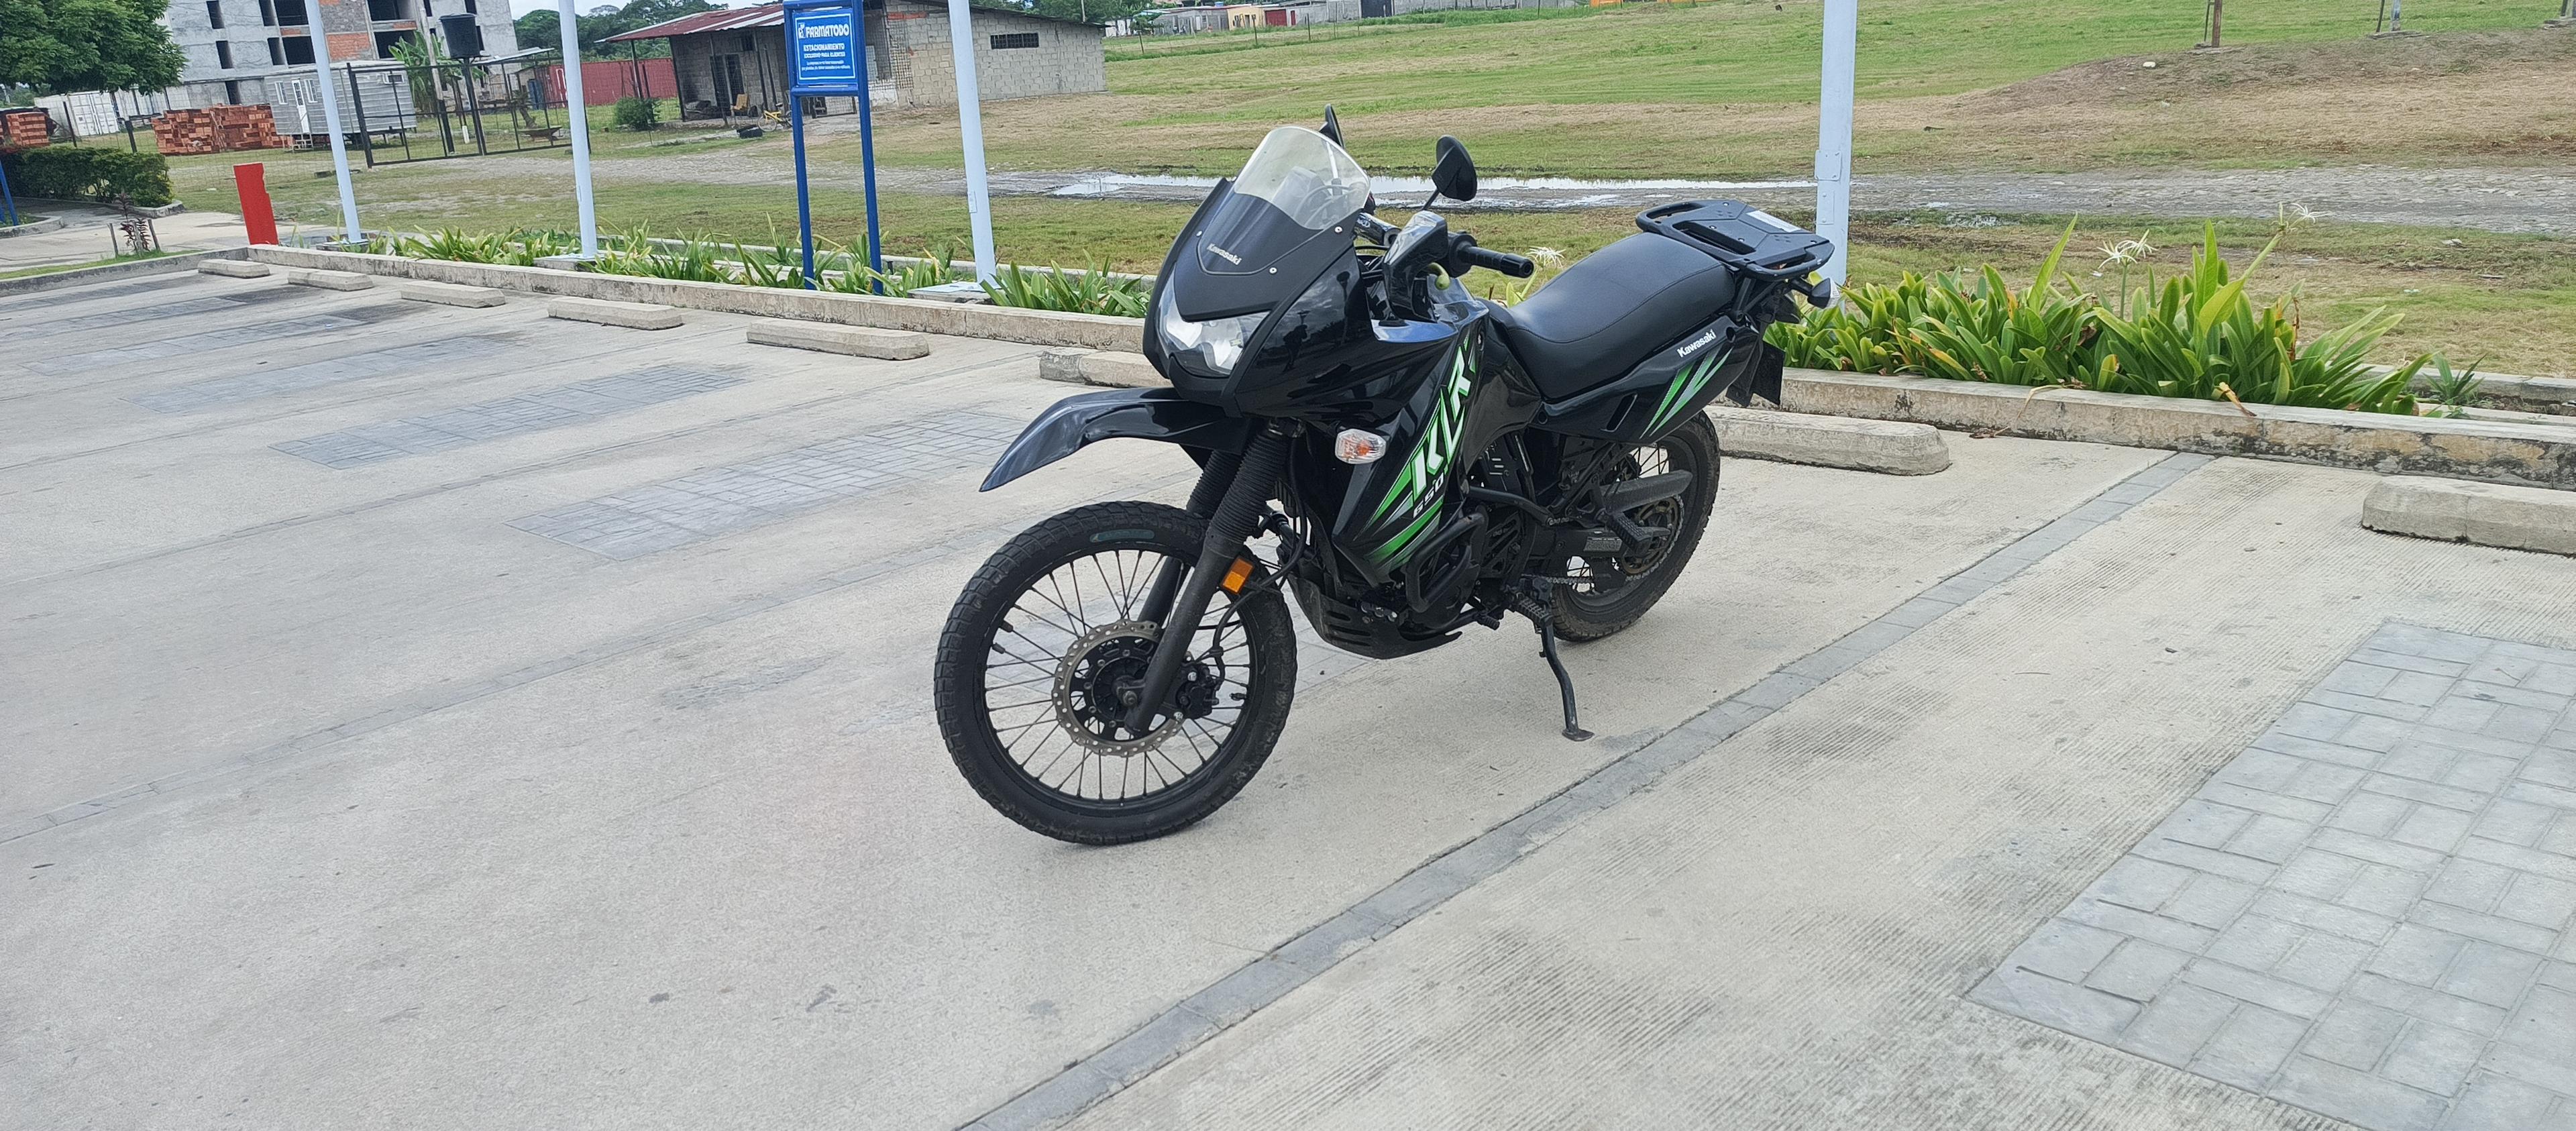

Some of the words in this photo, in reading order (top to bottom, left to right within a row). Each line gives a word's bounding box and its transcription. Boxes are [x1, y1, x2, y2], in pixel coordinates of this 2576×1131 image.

[806, 23, 850, 38] FARMATODO
[803, 43, 845, 52] ESTACIONAMIENTO
[1207, 243, 1242, 266] Kawasaki
[1676, 329, 1717, 358] Kawasaki
[1411, 345, 1472, 502] KLR
[1413, 472, 1444, 519] 650
